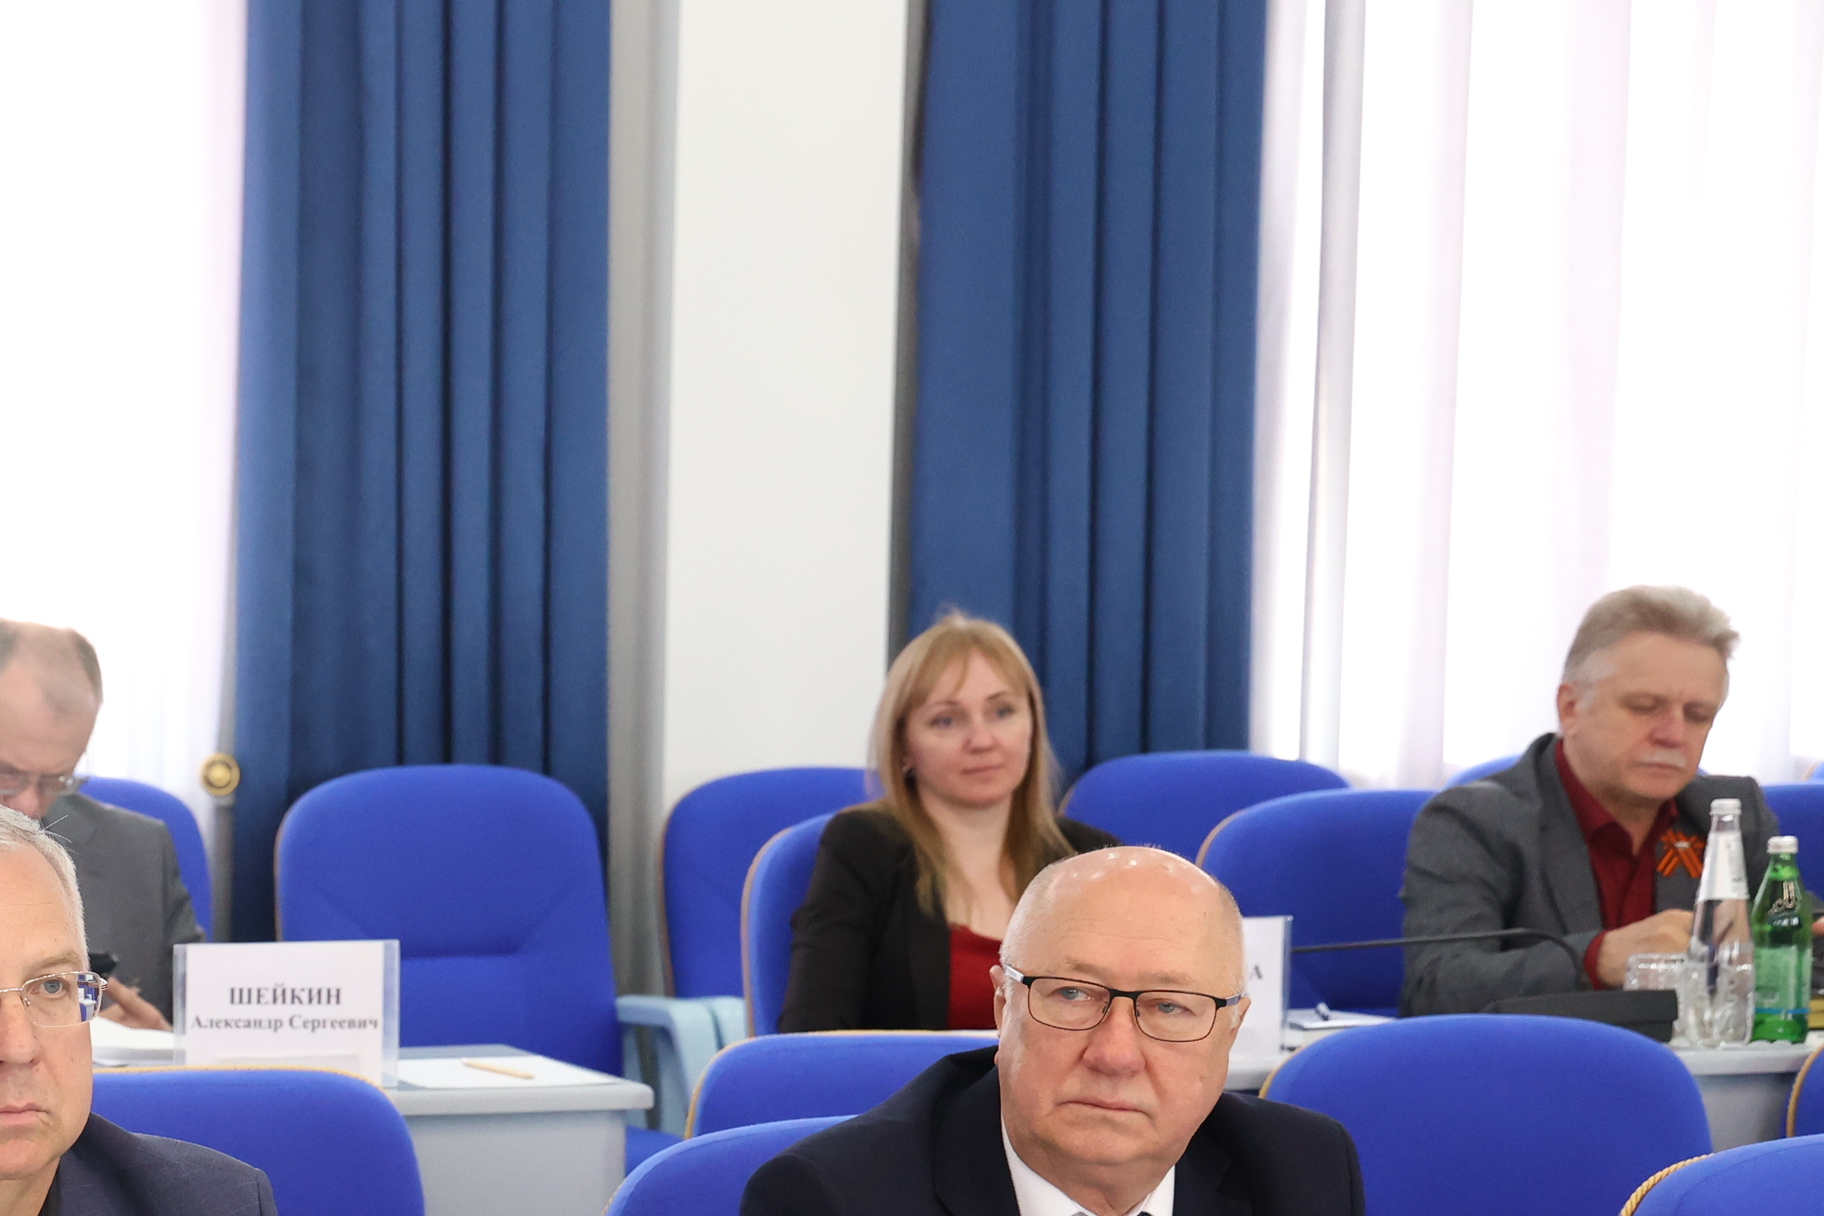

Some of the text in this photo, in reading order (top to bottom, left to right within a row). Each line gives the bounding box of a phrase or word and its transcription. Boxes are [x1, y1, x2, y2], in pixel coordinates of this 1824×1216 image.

[229, 983, 342, 1005] ШЕЙКИН
[190, 1014, 379, 1033] Александр Сергеевич
